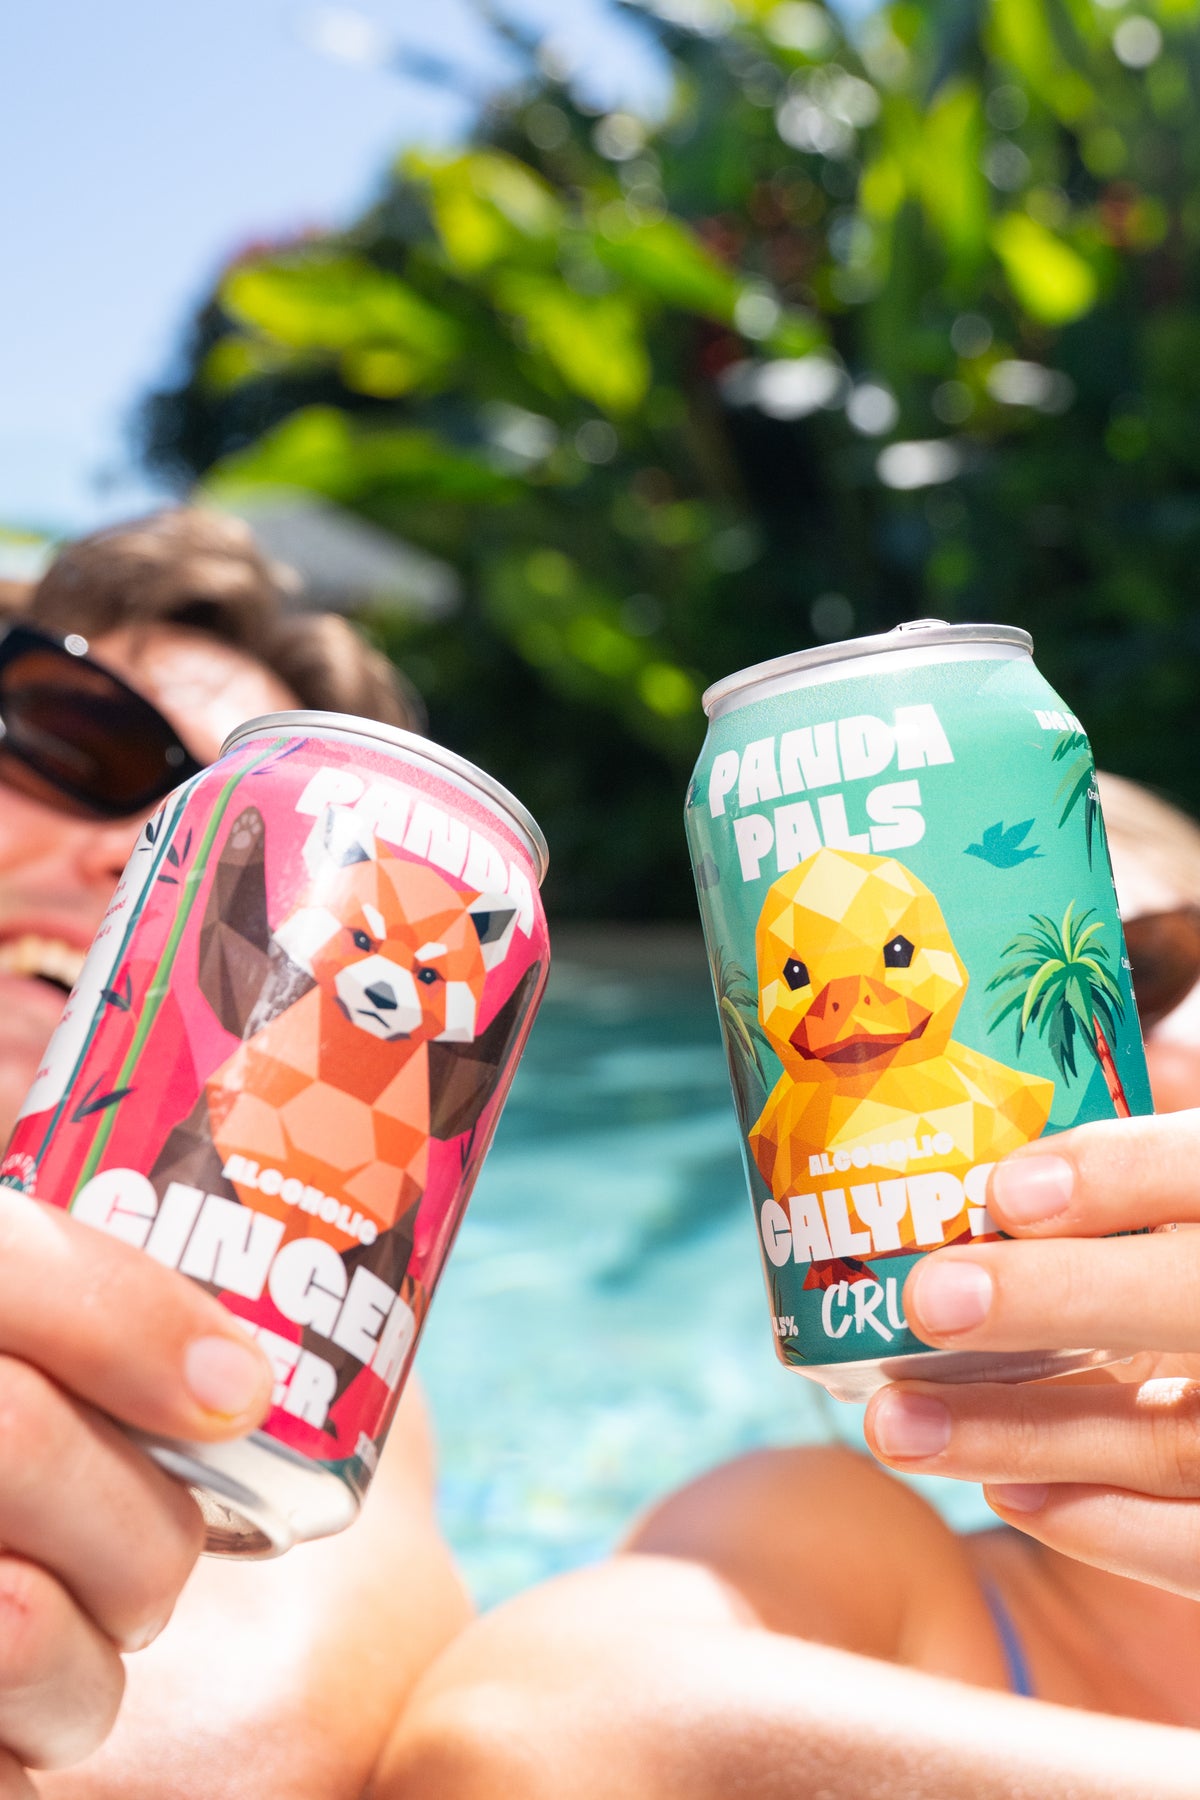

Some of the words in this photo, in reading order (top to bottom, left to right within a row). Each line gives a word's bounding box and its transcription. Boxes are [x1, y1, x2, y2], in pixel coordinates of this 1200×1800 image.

[708, 704, 955, 818] PANDA
[295, 766, 534, 939] PANDA
[733, 779, 926, 883] PALS
[221, 1153, 379, 1245] ALCOHOLIC
[808, 1132, 955, 1177] ALCOHOLIC
[761, 1161, 1004, 1267] CALYPS
[71, 1168, 416, 1391] GINGER
